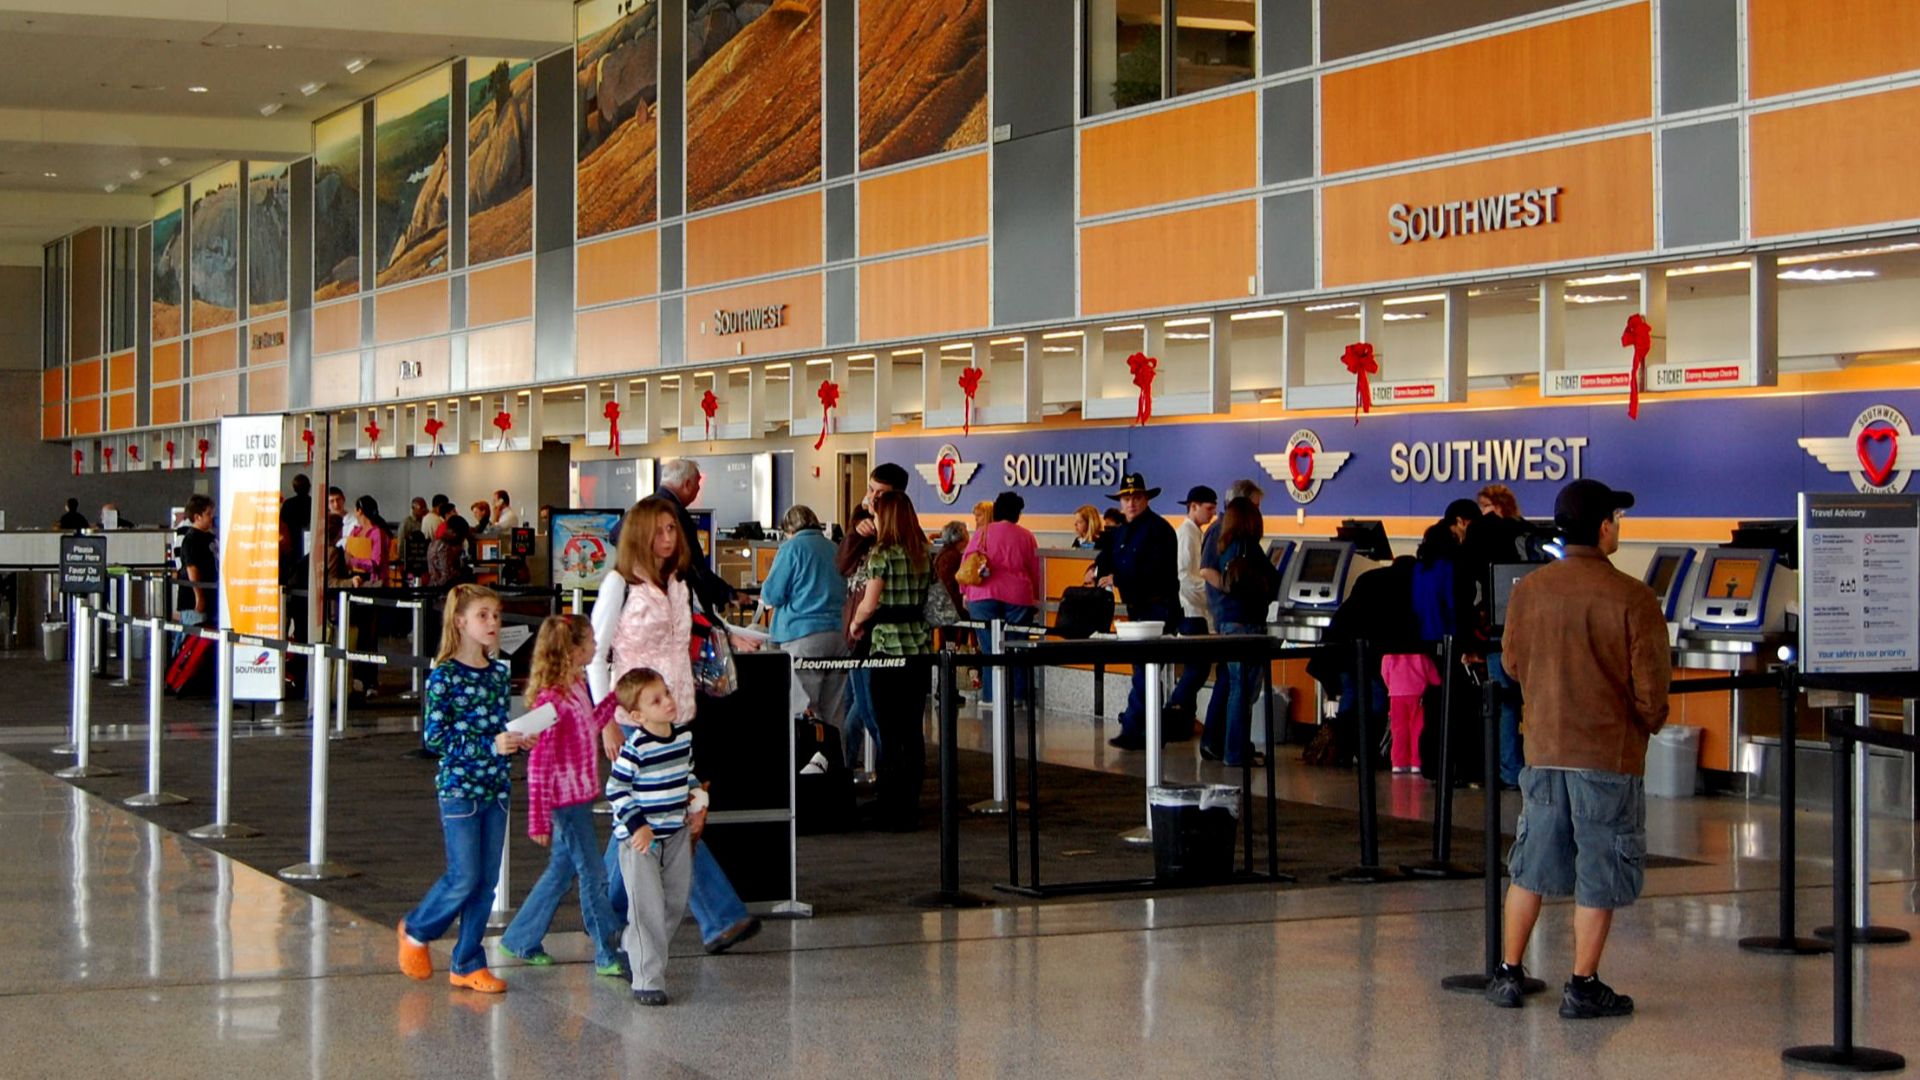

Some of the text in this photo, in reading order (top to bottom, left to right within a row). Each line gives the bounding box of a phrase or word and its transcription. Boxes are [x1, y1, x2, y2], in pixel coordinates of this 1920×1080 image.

[1388, 187, 1559, 245] SOUTHWEST
[714, 304, 785, 336] SOUTHWEST
[1555, 375, 1578, 390] E-TICKET
[1657, 369, 1682, 384] E-TICKET
[1858, 407, 1903, 427] SOUTHWEST
[246, 434, 277, 450] LET US
[232, 452, 277, 468] HELP YOU
[1390, 437, 1588, 483] SOUTHWEST
[1004, 452, 1129, 487] SOUTHWEST
[1811, 508, 1866, 519] Travel Advisory
[1836, 649, 1857, 660] safety
[1859, 649, 1865, 657] is
[1879, 648, 1906, 659] priority
[235, 666, 276, 674] SOUTHWEST
[802, 657, 906, 669] SOUTHWEST AIRLINES
